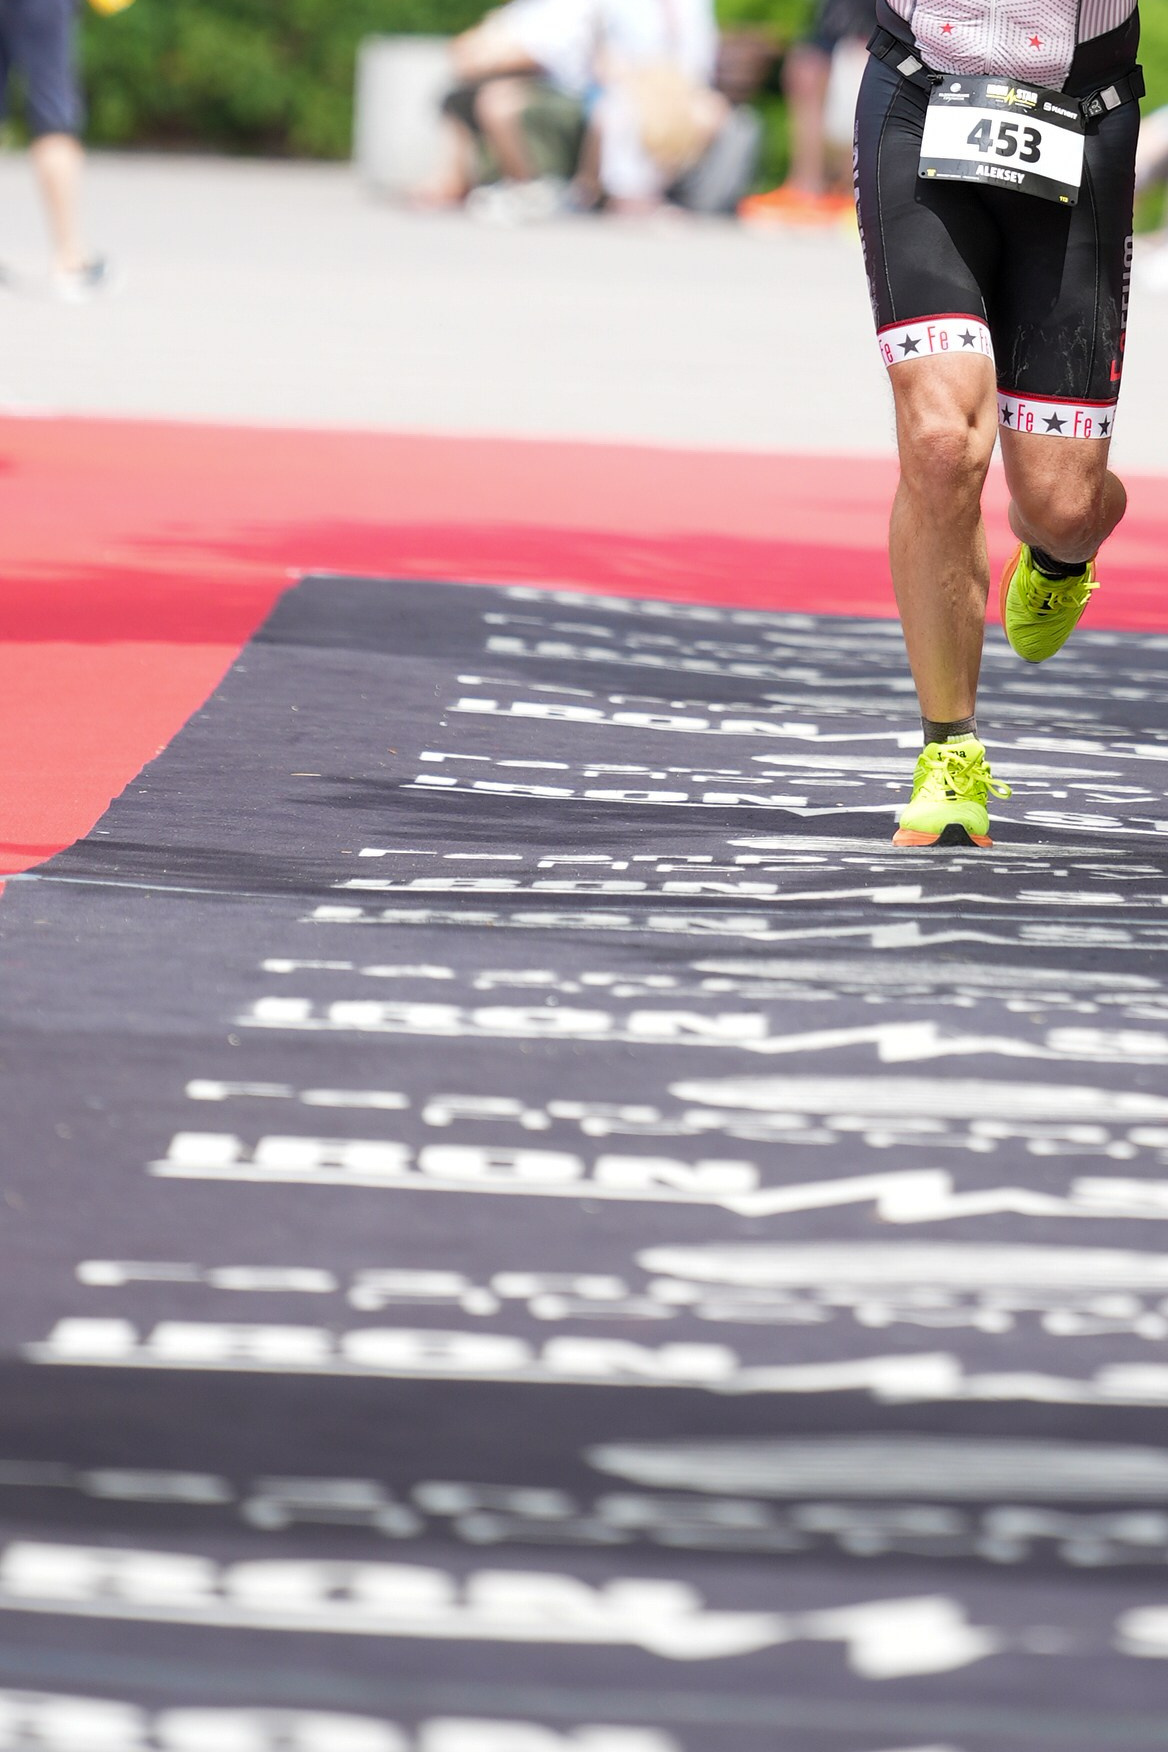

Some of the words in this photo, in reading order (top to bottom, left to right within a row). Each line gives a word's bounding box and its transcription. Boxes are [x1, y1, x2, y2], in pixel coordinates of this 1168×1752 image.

[967, 118, 1042, 163] 453
[975, 164, 1025, 184] ALEKSEY
[927, 326, 949, 352] Fe
[1017, 403, 1034, 432] Fe
[1074, 411, 1093, 438] Fe
[457, 698, 818, 736] IRON
[937, 750, 967, 762] Jma
[415, 775, 807, 806] IRON
[344, 878, 777, 894] IRON
[312, 905, 770, 931] IRON
[253, 997, 767, 1038] IRON
[165, 1131, 760, 1193] IRON
